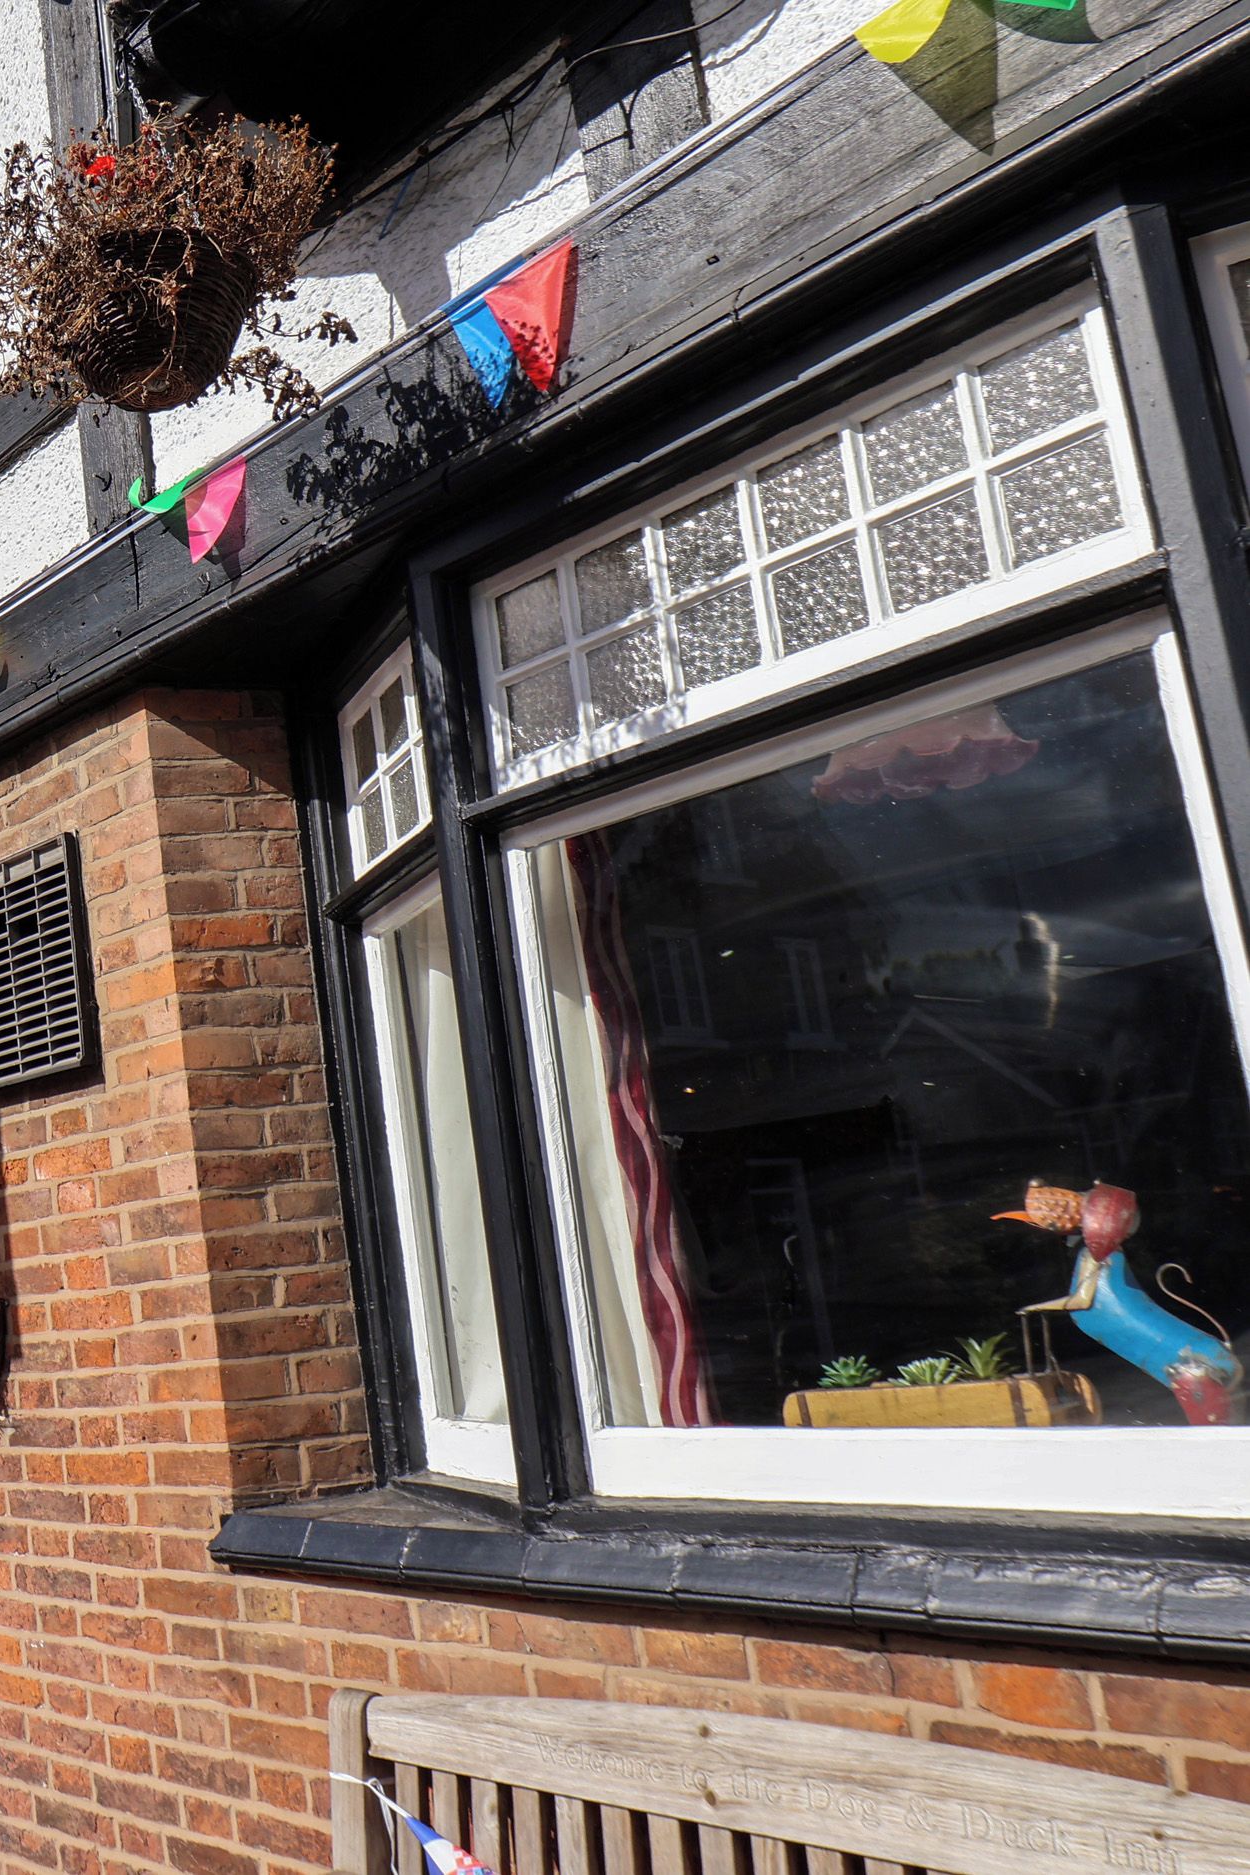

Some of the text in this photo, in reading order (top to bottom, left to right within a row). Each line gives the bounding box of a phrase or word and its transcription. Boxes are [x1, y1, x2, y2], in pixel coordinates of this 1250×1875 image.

[532, 1731, 1181, 1875] Welcome to the Dog & Duck Inn
